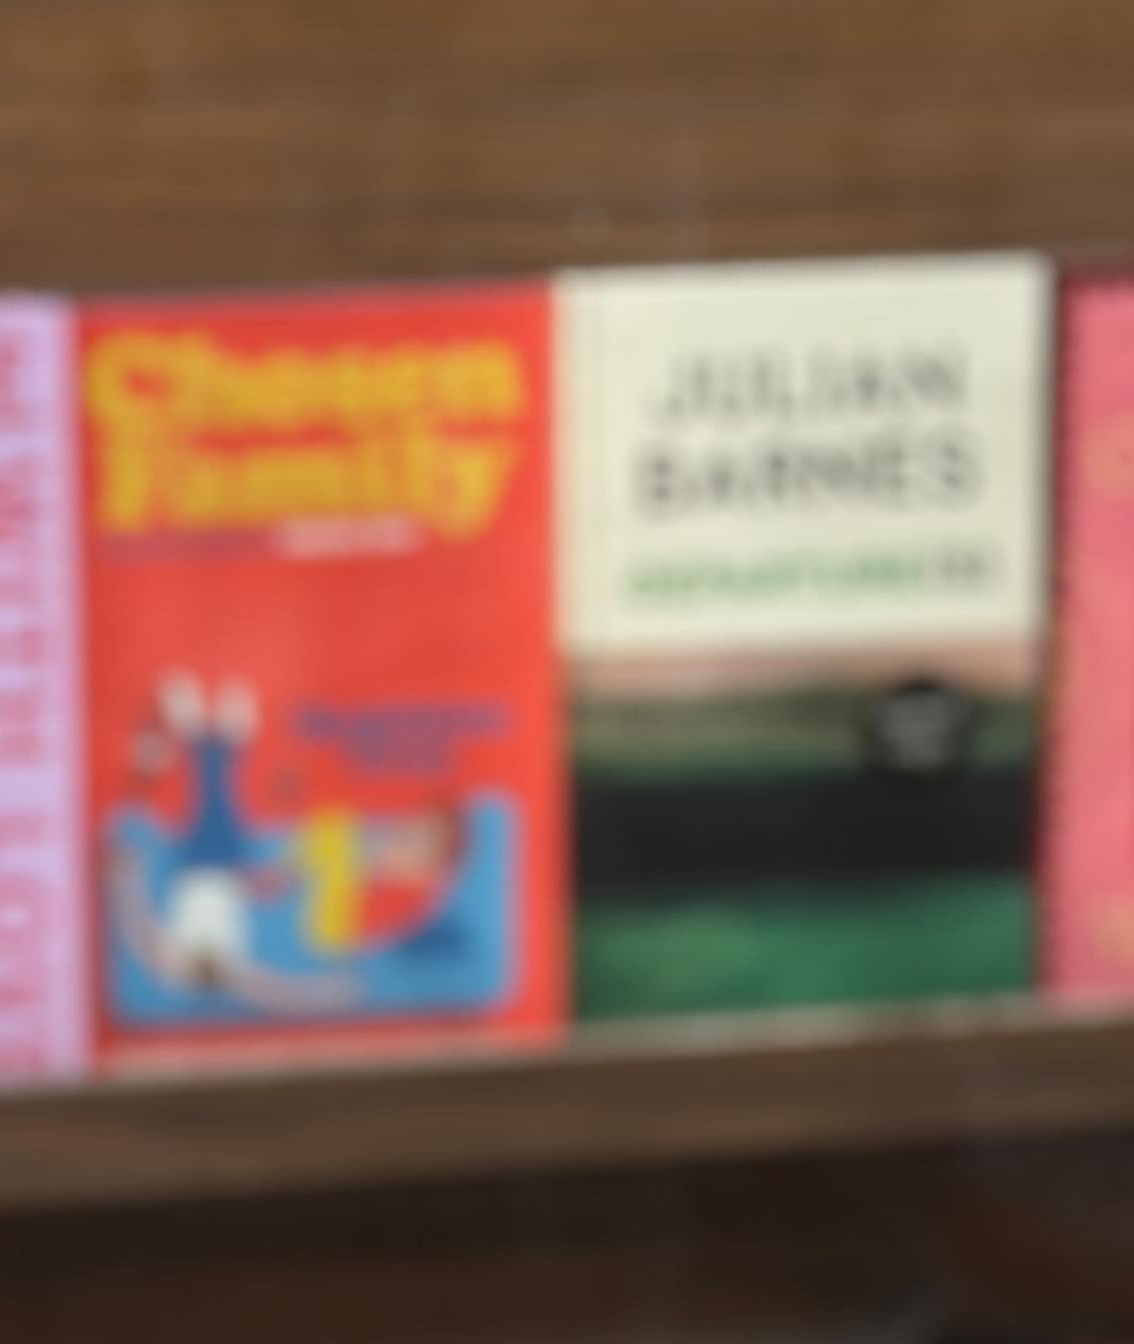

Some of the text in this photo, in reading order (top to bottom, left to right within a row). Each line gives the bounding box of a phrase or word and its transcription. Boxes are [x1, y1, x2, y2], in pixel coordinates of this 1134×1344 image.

[86, 330, 525, 432] Chosen
[650, 342, 970, 428] JULIAN
[96, 412, 522, 541] Family
[632, 426, 988, 524] BARNES
